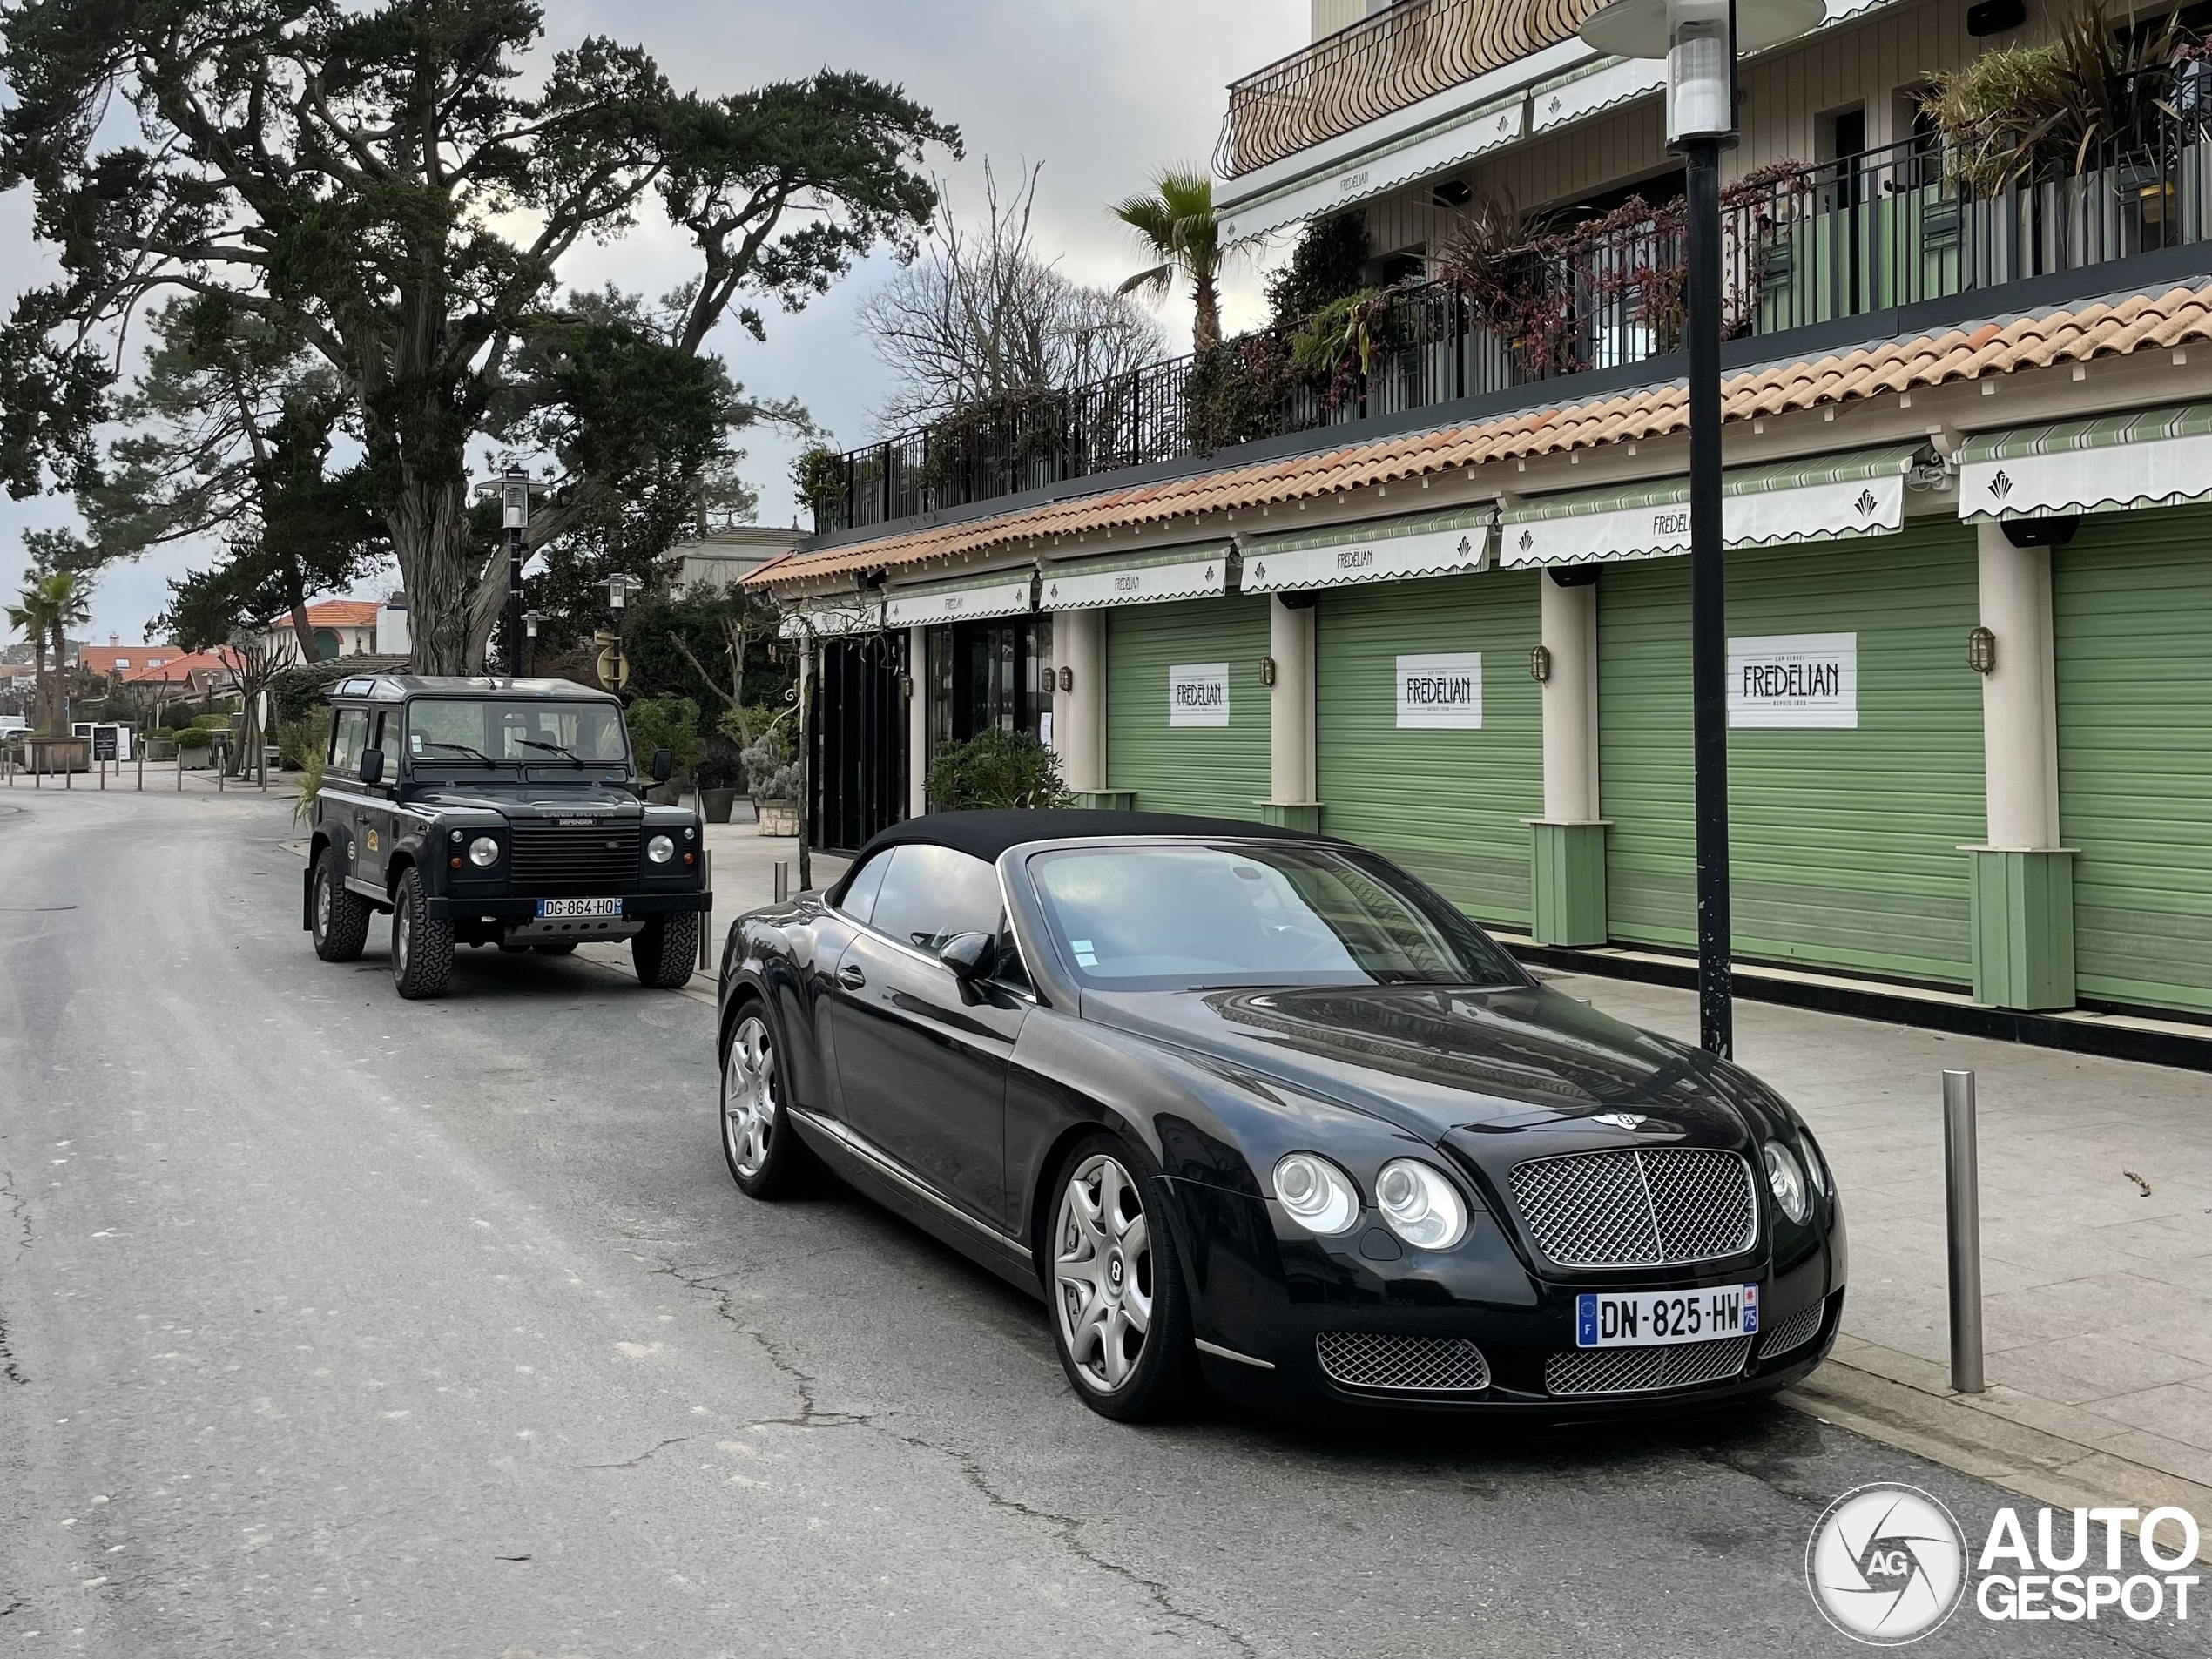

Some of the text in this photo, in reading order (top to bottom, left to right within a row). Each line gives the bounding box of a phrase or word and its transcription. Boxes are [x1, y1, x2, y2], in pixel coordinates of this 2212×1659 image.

[576, 809, 615, 818] ROVER
[545, 899, 614, 915] DG-864-HQ
[1584, 1292, 1757, 1339] F DN-825-HW 75
